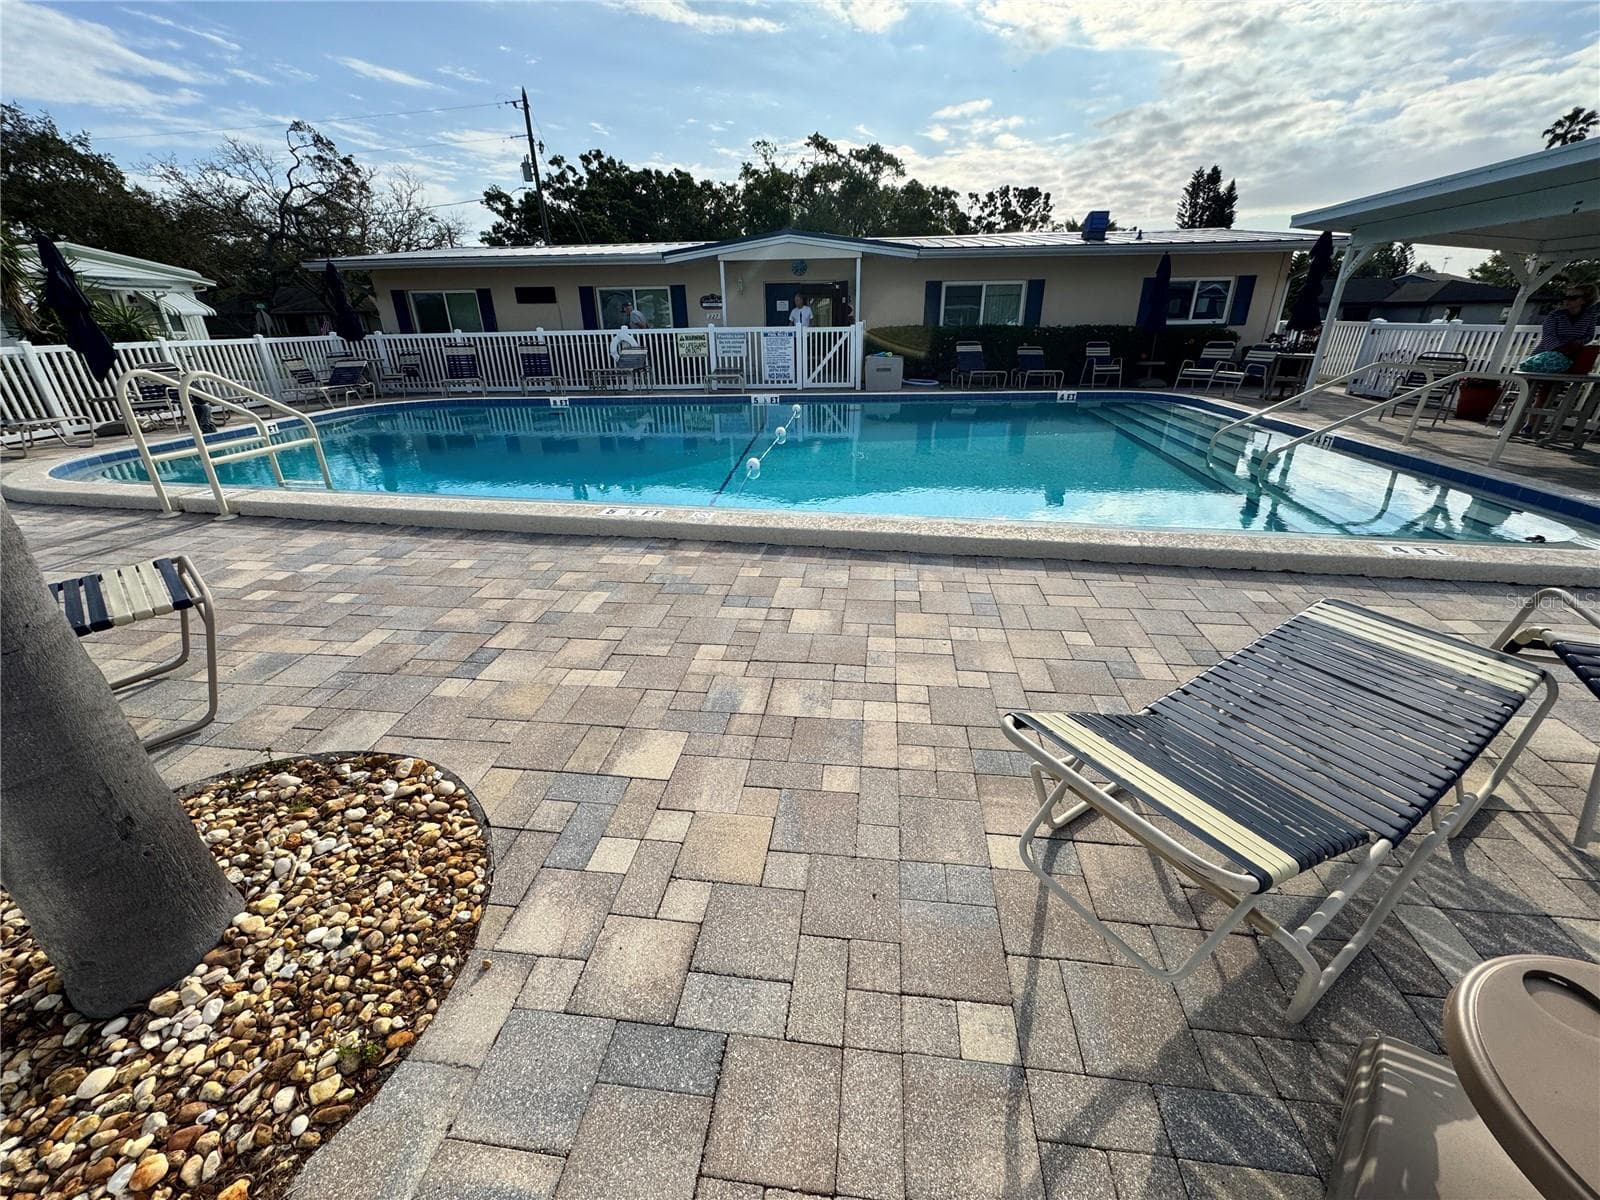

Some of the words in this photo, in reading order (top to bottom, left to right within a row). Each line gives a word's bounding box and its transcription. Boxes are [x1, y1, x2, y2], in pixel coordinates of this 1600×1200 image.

[685, 342, 706, 350] LIFEGUARD
[1391, 546, 1410, 554] 4
[1413, 547, 1446, 555] FT
